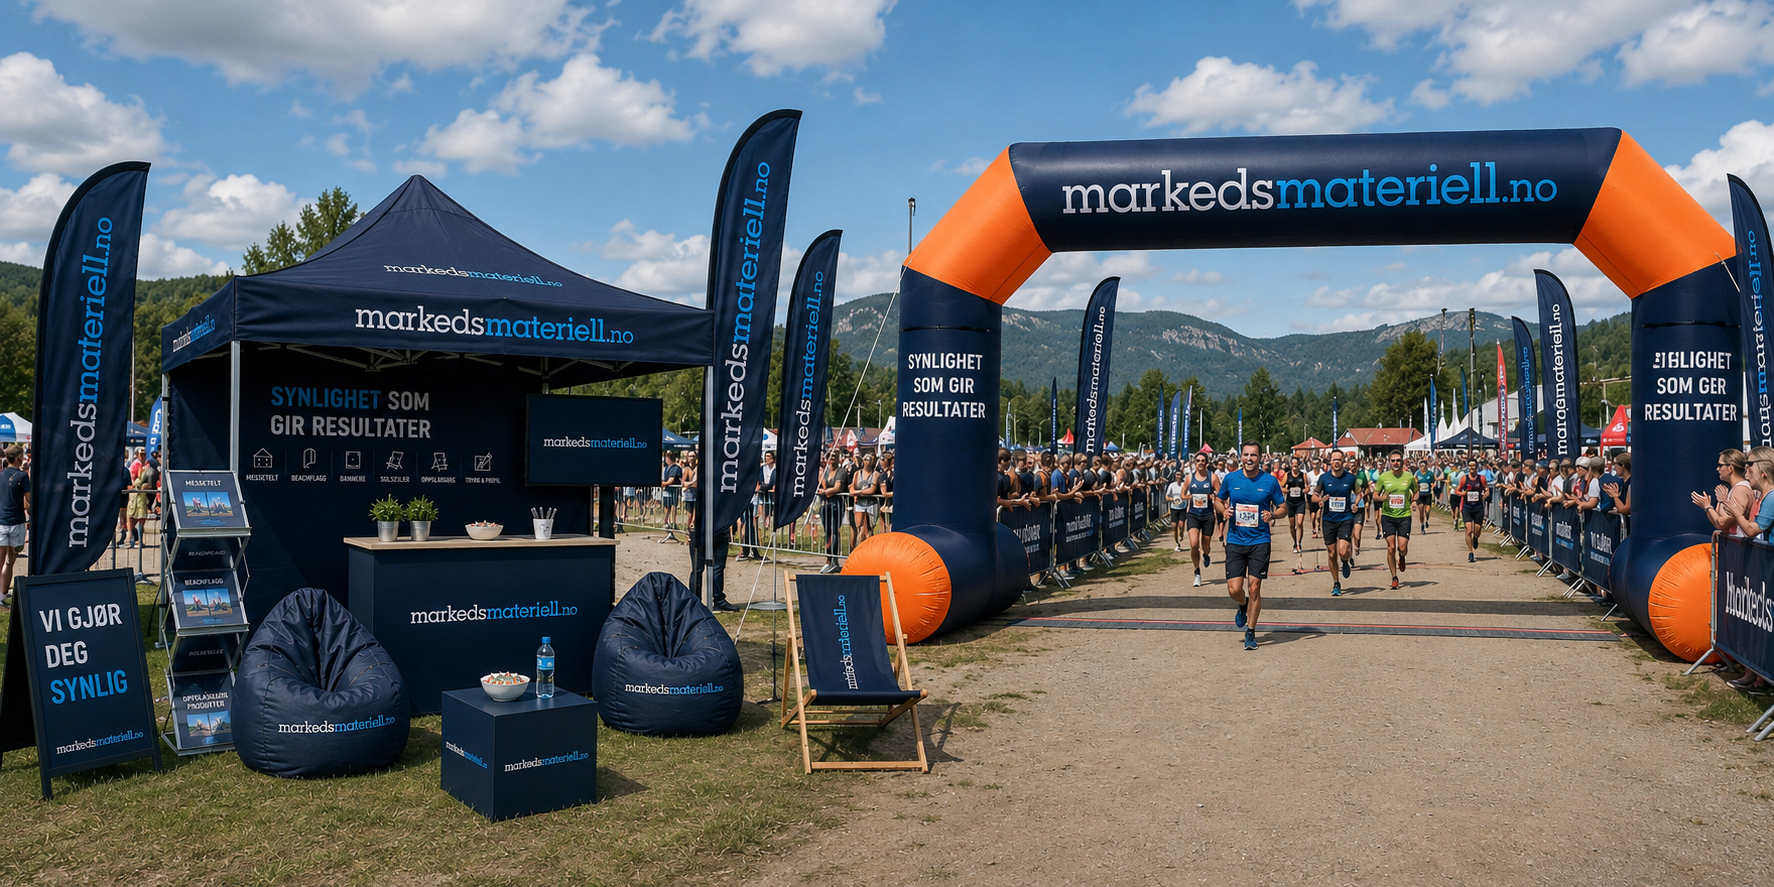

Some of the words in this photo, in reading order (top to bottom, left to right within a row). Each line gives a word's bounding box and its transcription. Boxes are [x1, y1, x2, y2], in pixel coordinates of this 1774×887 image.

[1062, 161, 1558, 214] markedsmateriell.no
[384, 264, 563, 288] markedsmateriell.no
[355, 306, 634, 344] markedsmateriell.no
[720, 161, 770, 494] markedsmateriell.no
[908, 353, 983, 371] SYNLIGHET
[68, 216, 113, 549] markedsmateriell.no
[794, 270, 824, 498] markedsmateriell.no
[914, 377, 943, 393] SOM
[949, 377, 974, 394] GIR
[1656, 377, 1693, 395] SOM
[1698, 377, 1727, 395] GER
[270, 385, 381, 410] SYNLIGHET
[387, 390, 430, 411] SOM
[902, 401, 986, 419] RESULTATER
[1644, 403, 1737, 421] RESULTATER
[270, 414, 305, 436] GIR
[312, 415, 432, 439] RESULTATER
[543, 435, 648, 449] markedsmateriell.no
[39, 609, 63, 633] VI
[67, 603, 123, 630] GJØR
[410, 600, 578, 624] markedsmateriell.no
[45, 640, 88, 669] DEG
[50, 669, 128, 705] SYNLIG
[624, 682, 724, 695] markedsmateriell.no
[277, 714, 396, 734] markedsmateriell.no
